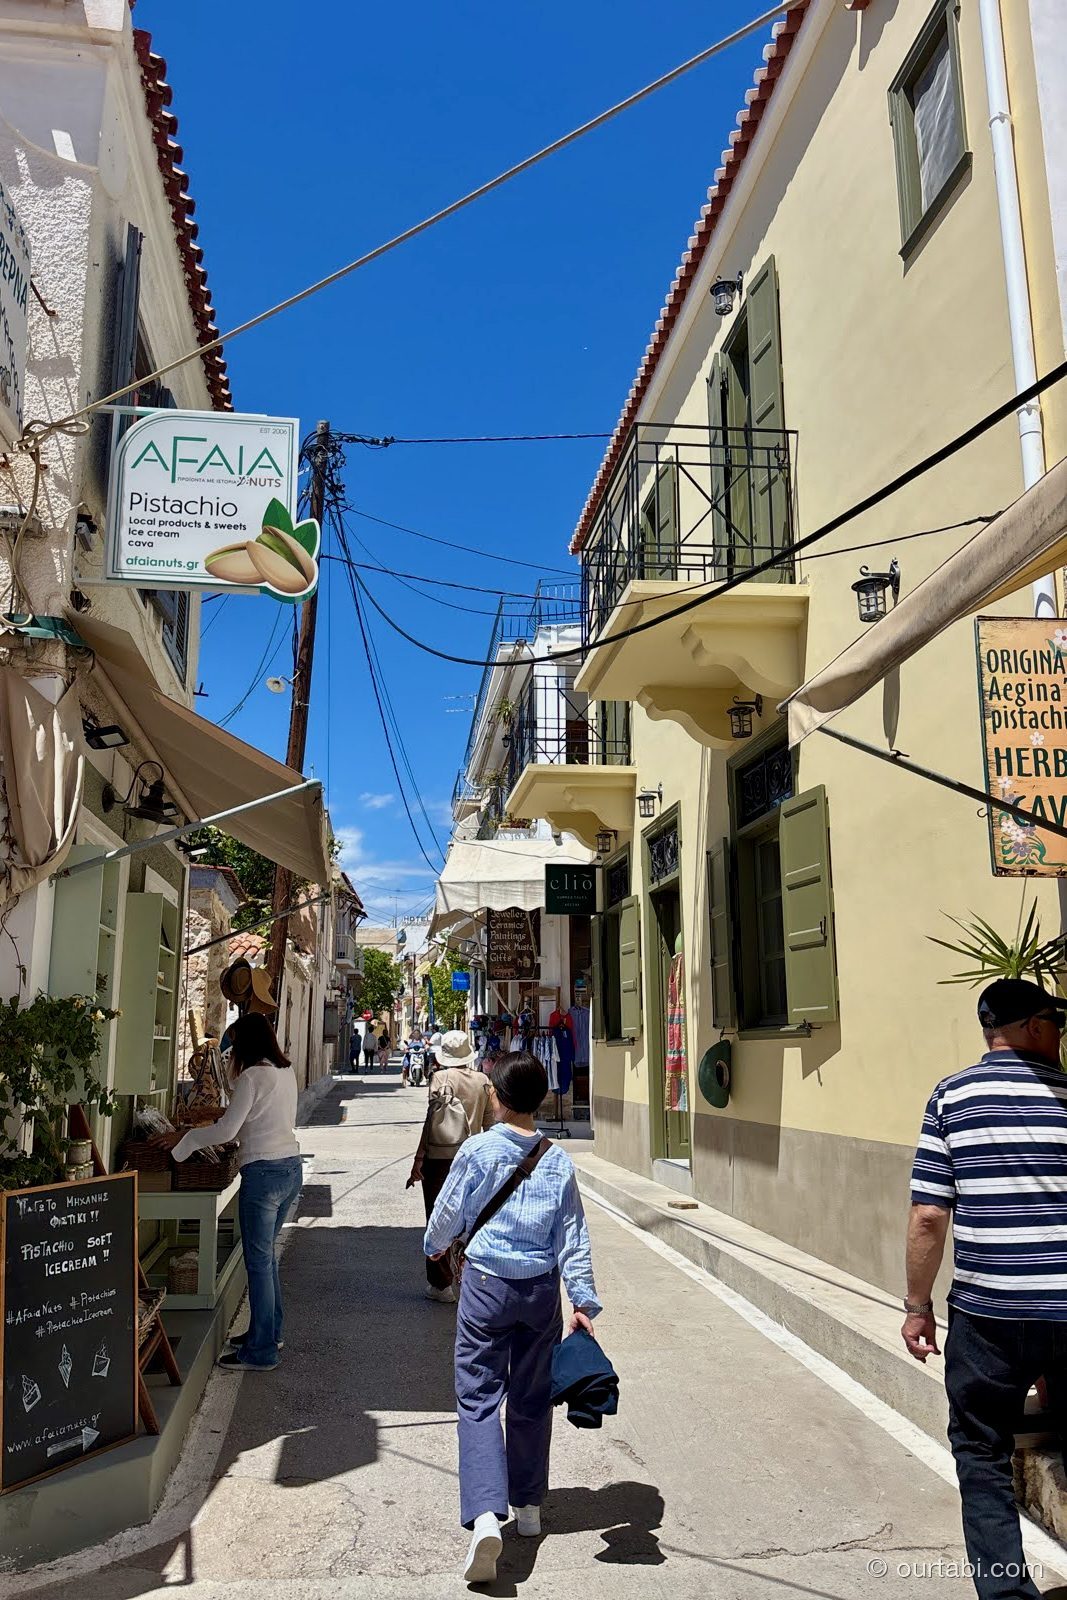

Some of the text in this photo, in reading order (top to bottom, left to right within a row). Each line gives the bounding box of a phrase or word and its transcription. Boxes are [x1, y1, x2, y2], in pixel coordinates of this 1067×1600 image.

[131, 436, 284, 484] AFAIA
[249, 477, 281, 488] NUTS
[129, 492, 238, 517] Pistachio
[129, 516, 247, 531] Local products & sweets
[128, 528, 180, 538] Ice cream
[128, 539, 154, 548] cava
[126, 555, 199, 571] afaianuts.gr
[986, 649, 1066, 675] ORIGINA
[489, 920, 525, 929] Ceramics
[490, 930, 527, 942] Paintings
[489, 941, 511, 951] Greek
[489, 952, 512, 962] Gifts
[66, 1192, 109, 1208] ΜΗΧΑΝΗΣ
[21, 1240, 74, 1261] PISTACHIO
[45, 1255, 97, 1277] ICECREAM
[7, 1412, 101, 1453] www.afaianuts.gr
